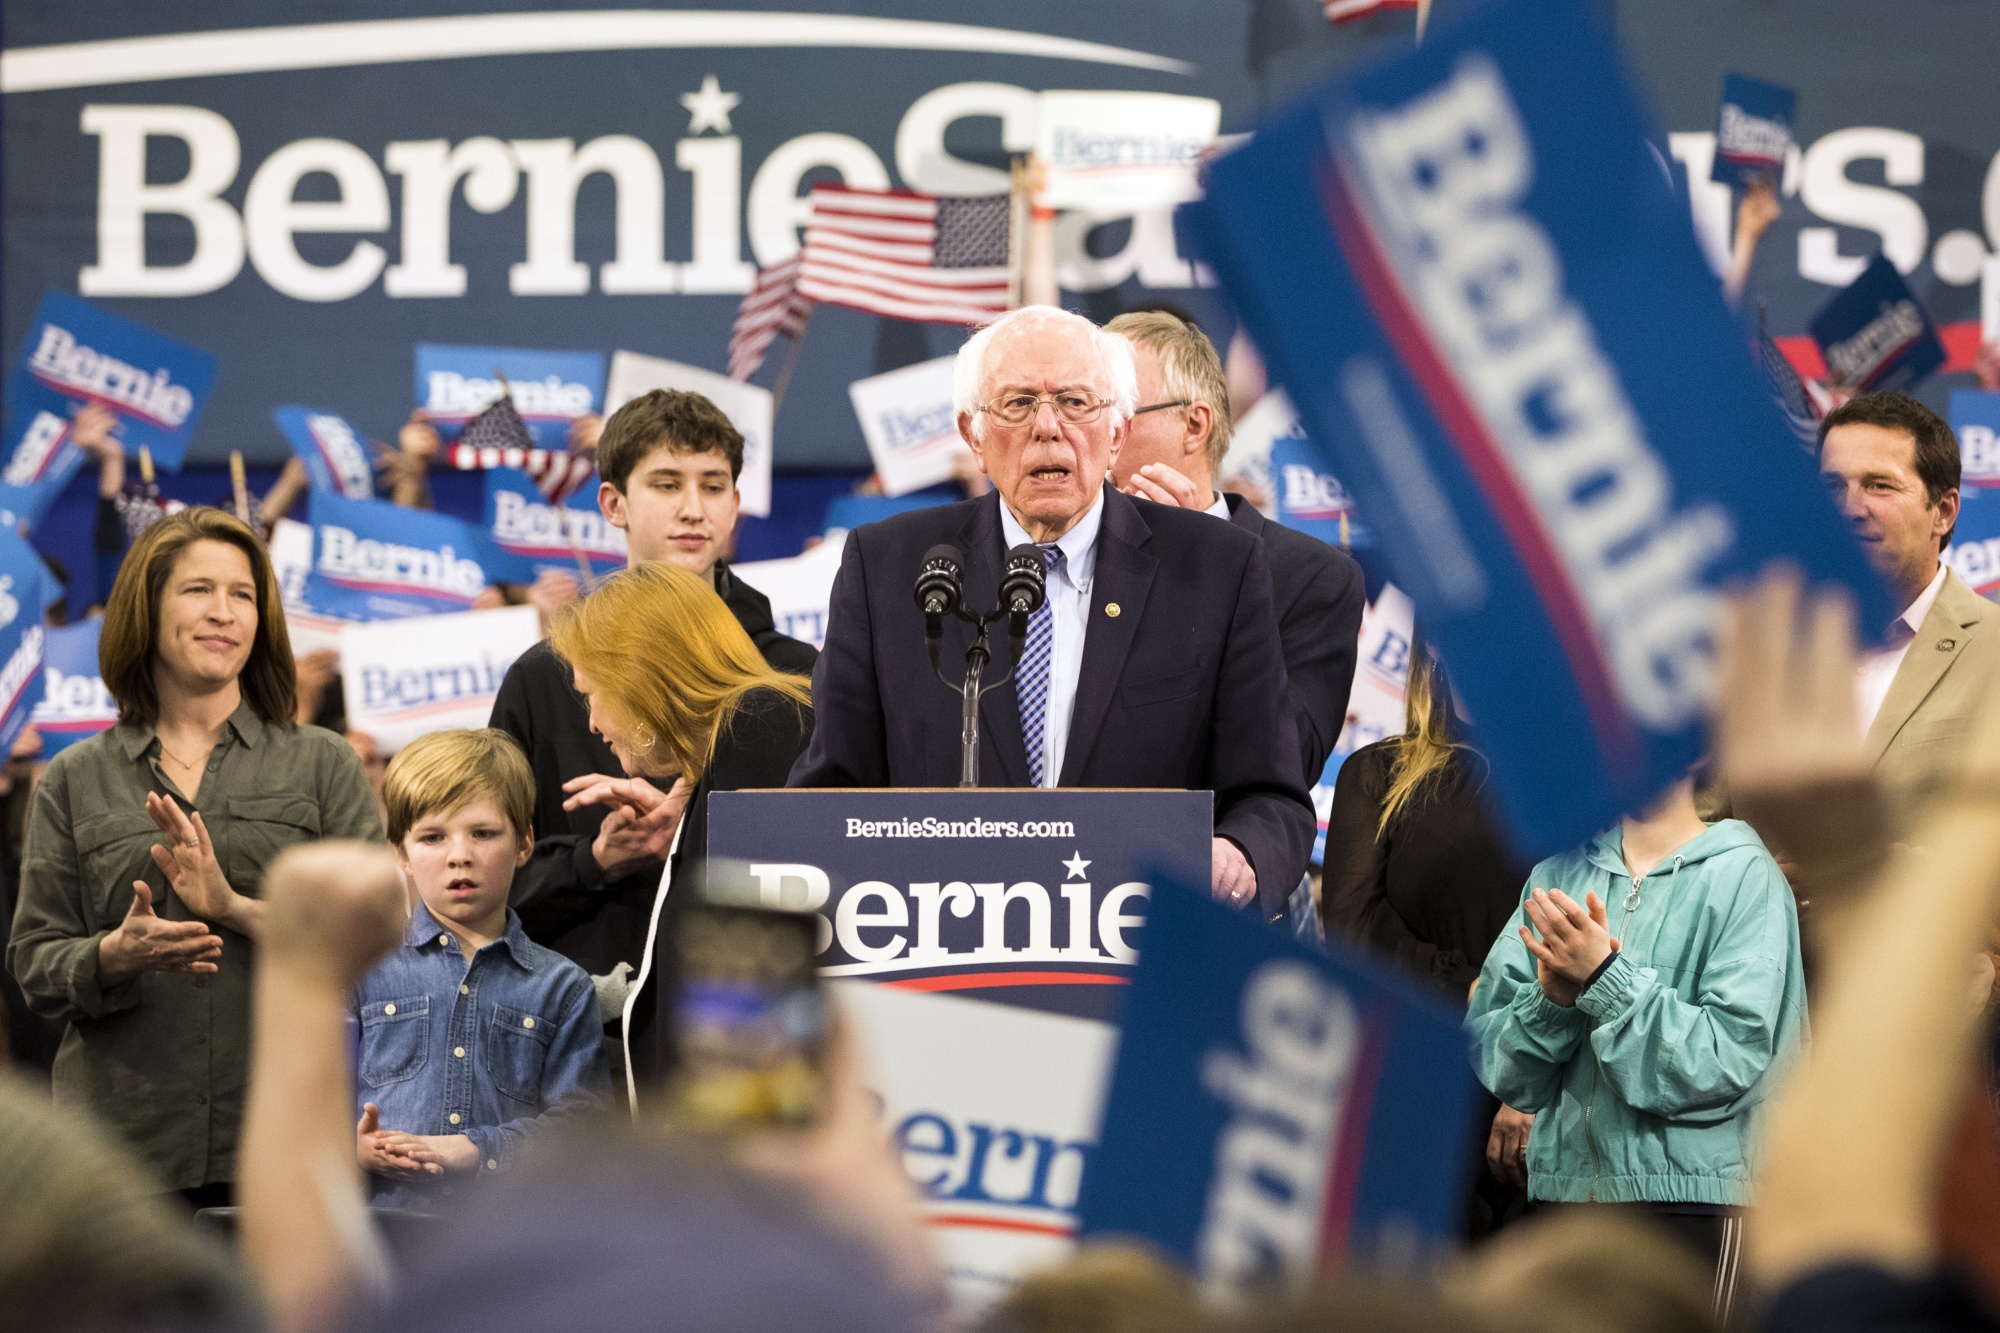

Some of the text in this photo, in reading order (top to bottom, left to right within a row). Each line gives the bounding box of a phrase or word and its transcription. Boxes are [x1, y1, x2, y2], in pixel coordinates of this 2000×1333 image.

[28, 321, 194, 428] Bernie
[1342, 52, 1738, 737] Bernie
[317, 523, 486, 598] Bernie
[845, 816, 1075, 838] BernieSanders.com
